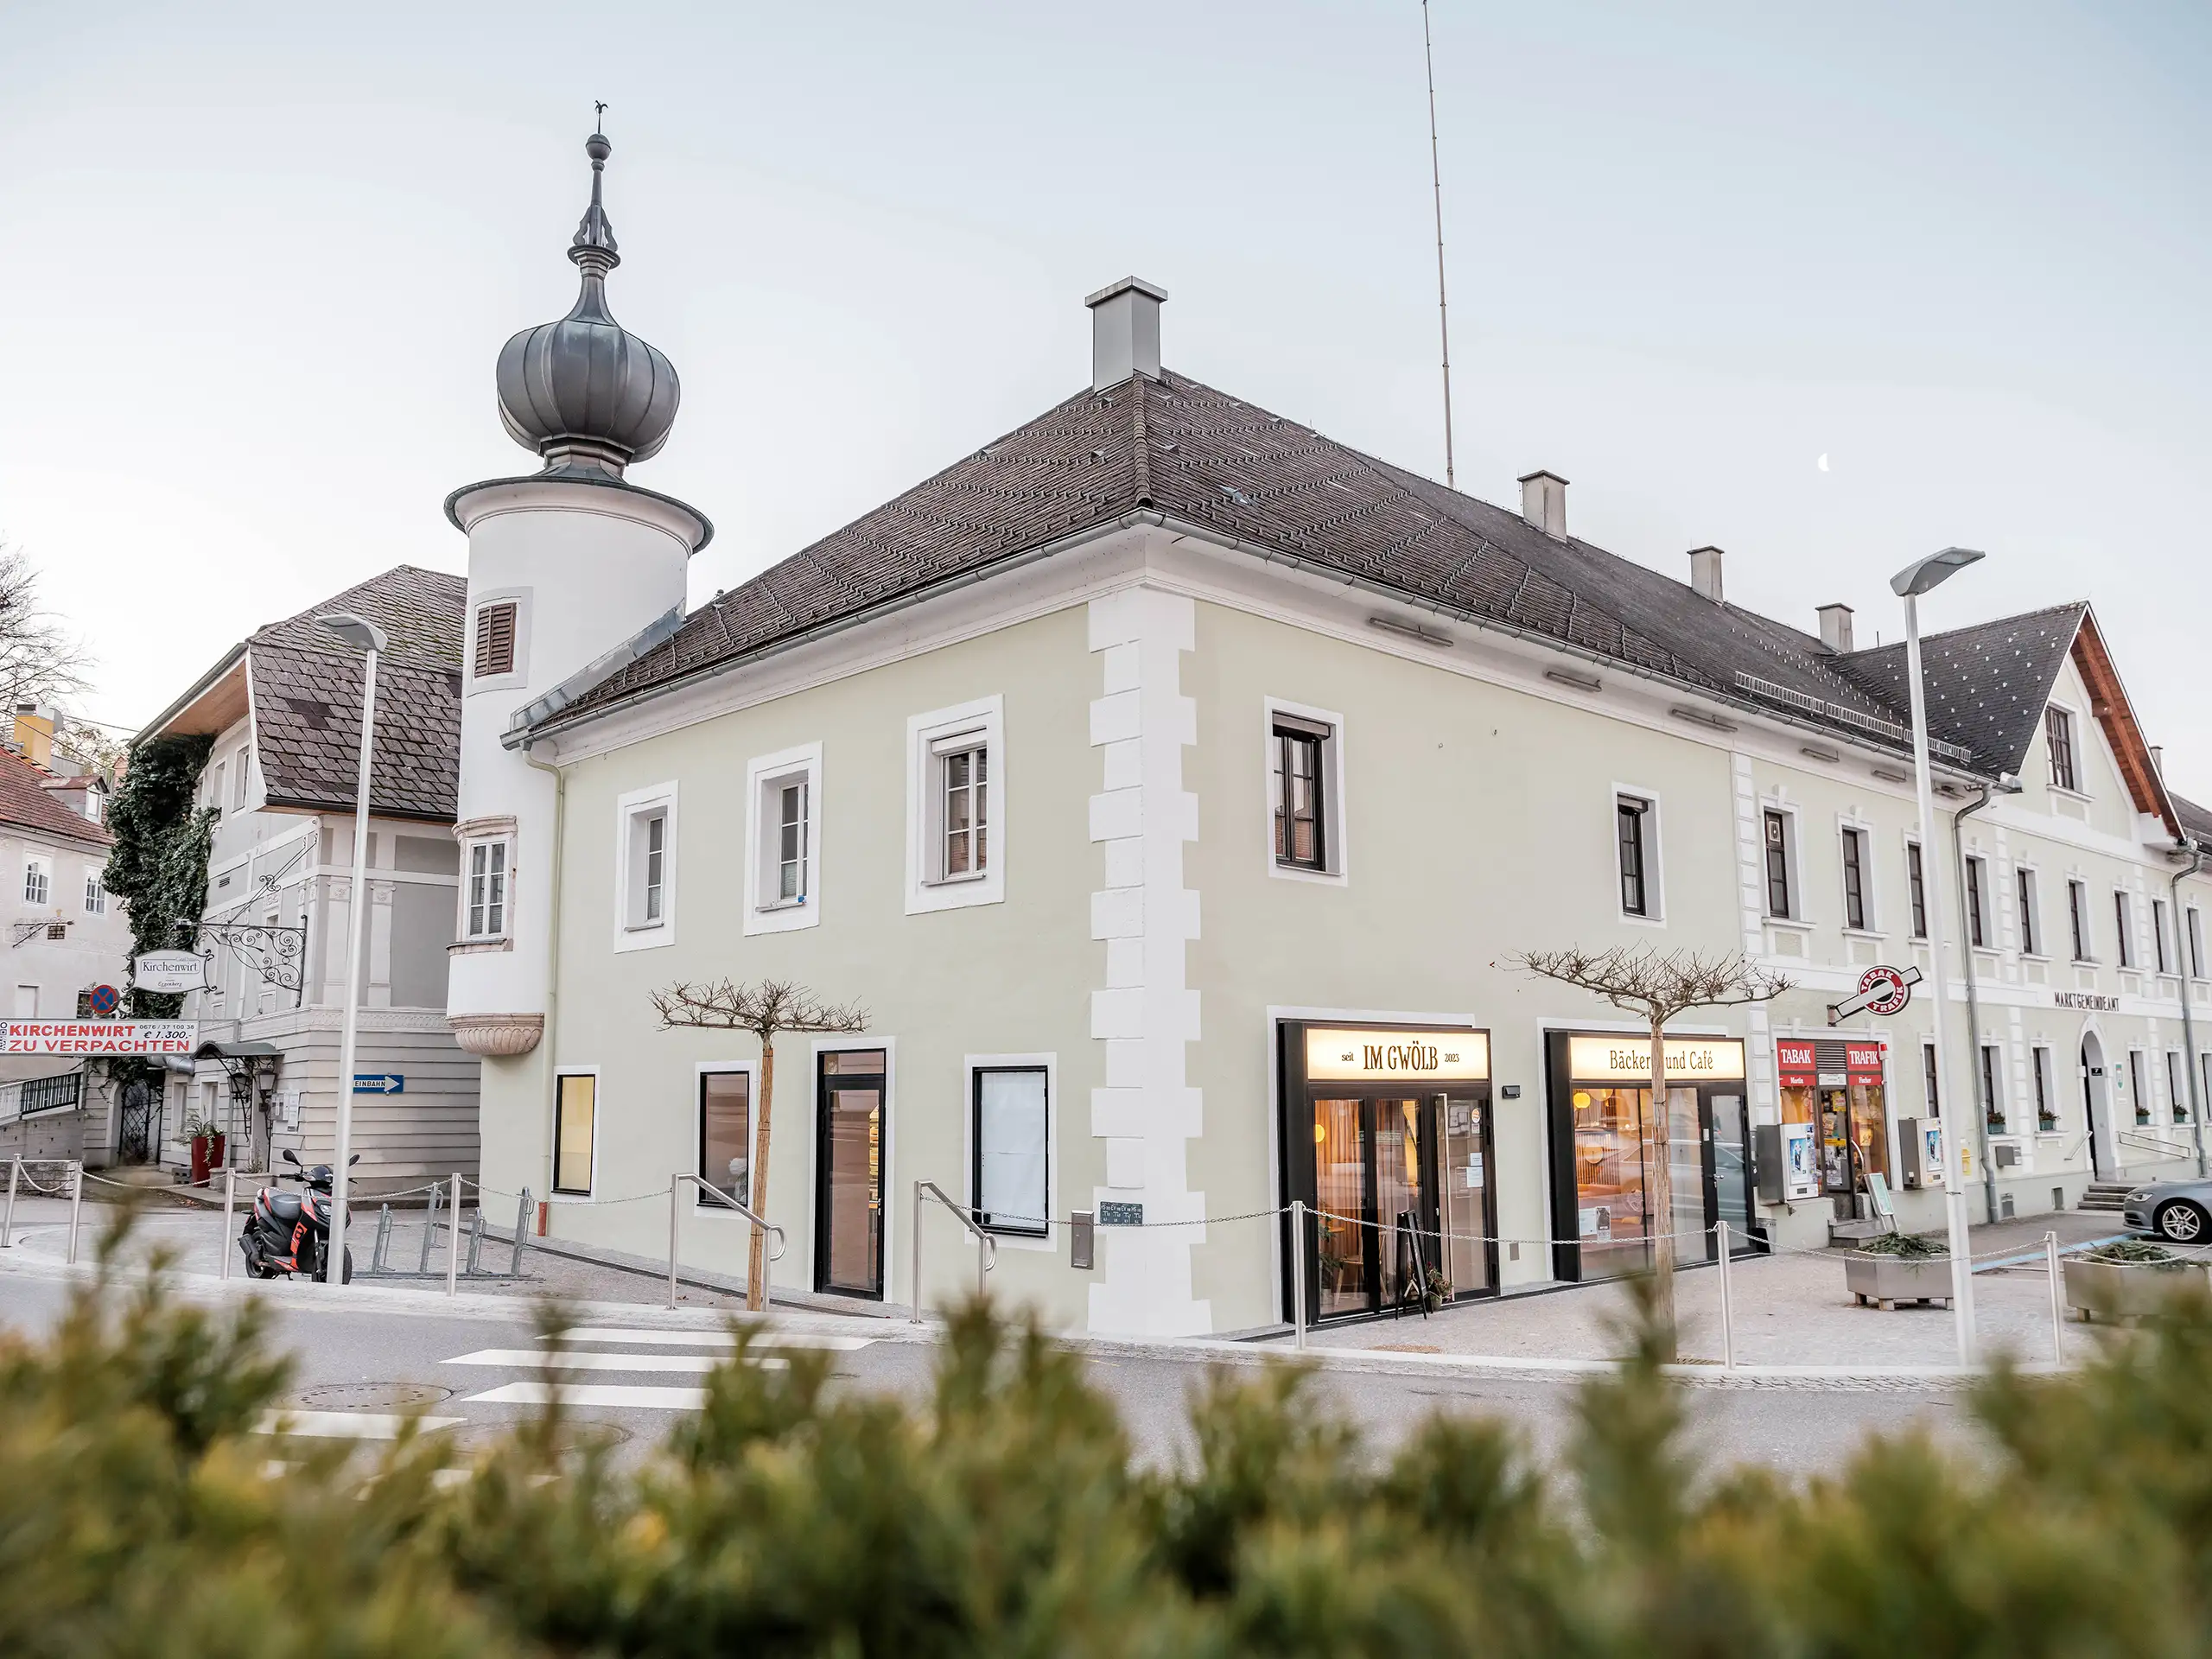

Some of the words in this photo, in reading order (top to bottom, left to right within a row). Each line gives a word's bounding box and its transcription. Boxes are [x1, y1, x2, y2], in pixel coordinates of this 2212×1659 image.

[143, 961, 198, 972] Kirchenwirt
[1861, 969, 1894, 991] TABAK
[1872, 986, 1904, 1012] TRAFIK
[2054, 991, 2120, 1012] MARKTGEMEINDEAMT
[10, 1025, 136, 1037] KIRCHENWIRT
[8, 1039, 37, 1052] ZU
[45, 1039, 190, 1052] VERPACHTEN
[1341, 1052, 1355, 1062] seit
[1363, 1045, 1383, 1070] IM
[1387, 1040, 1439, 1071] GWÖLB
[1444, 1053, 1460, 1063] 2023
[1610, 1050, 1651, 1070] Bäcker
[1665, 1051, 1686, 1070] und
[1689, 1051, 1713, 1070] Café
[1780, 1049, 1812, 1064] TABAK
[1848, 1050, 1879, 1065] TRAFIK
